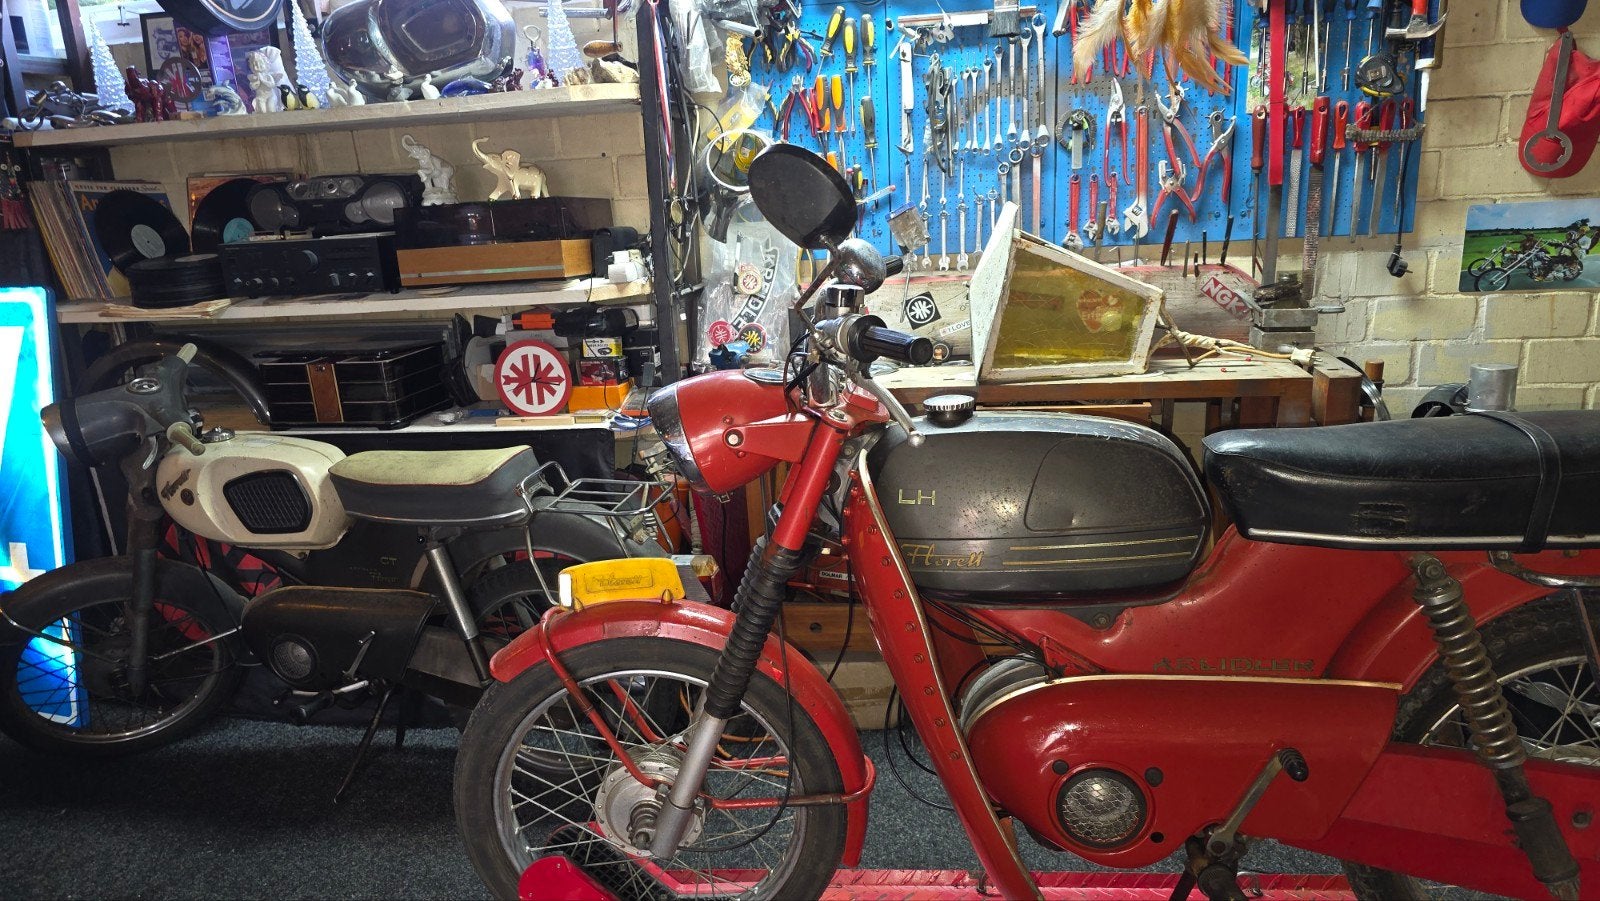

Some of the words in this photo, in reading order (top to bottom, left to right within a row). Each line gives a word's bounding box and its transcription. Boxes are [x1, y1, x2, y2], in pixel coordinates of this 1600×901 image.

[1202, 279, 1247, 319] NGK
[898, 488, 936, 506] LH
[821, 571, 843, 579] DOLMAR
